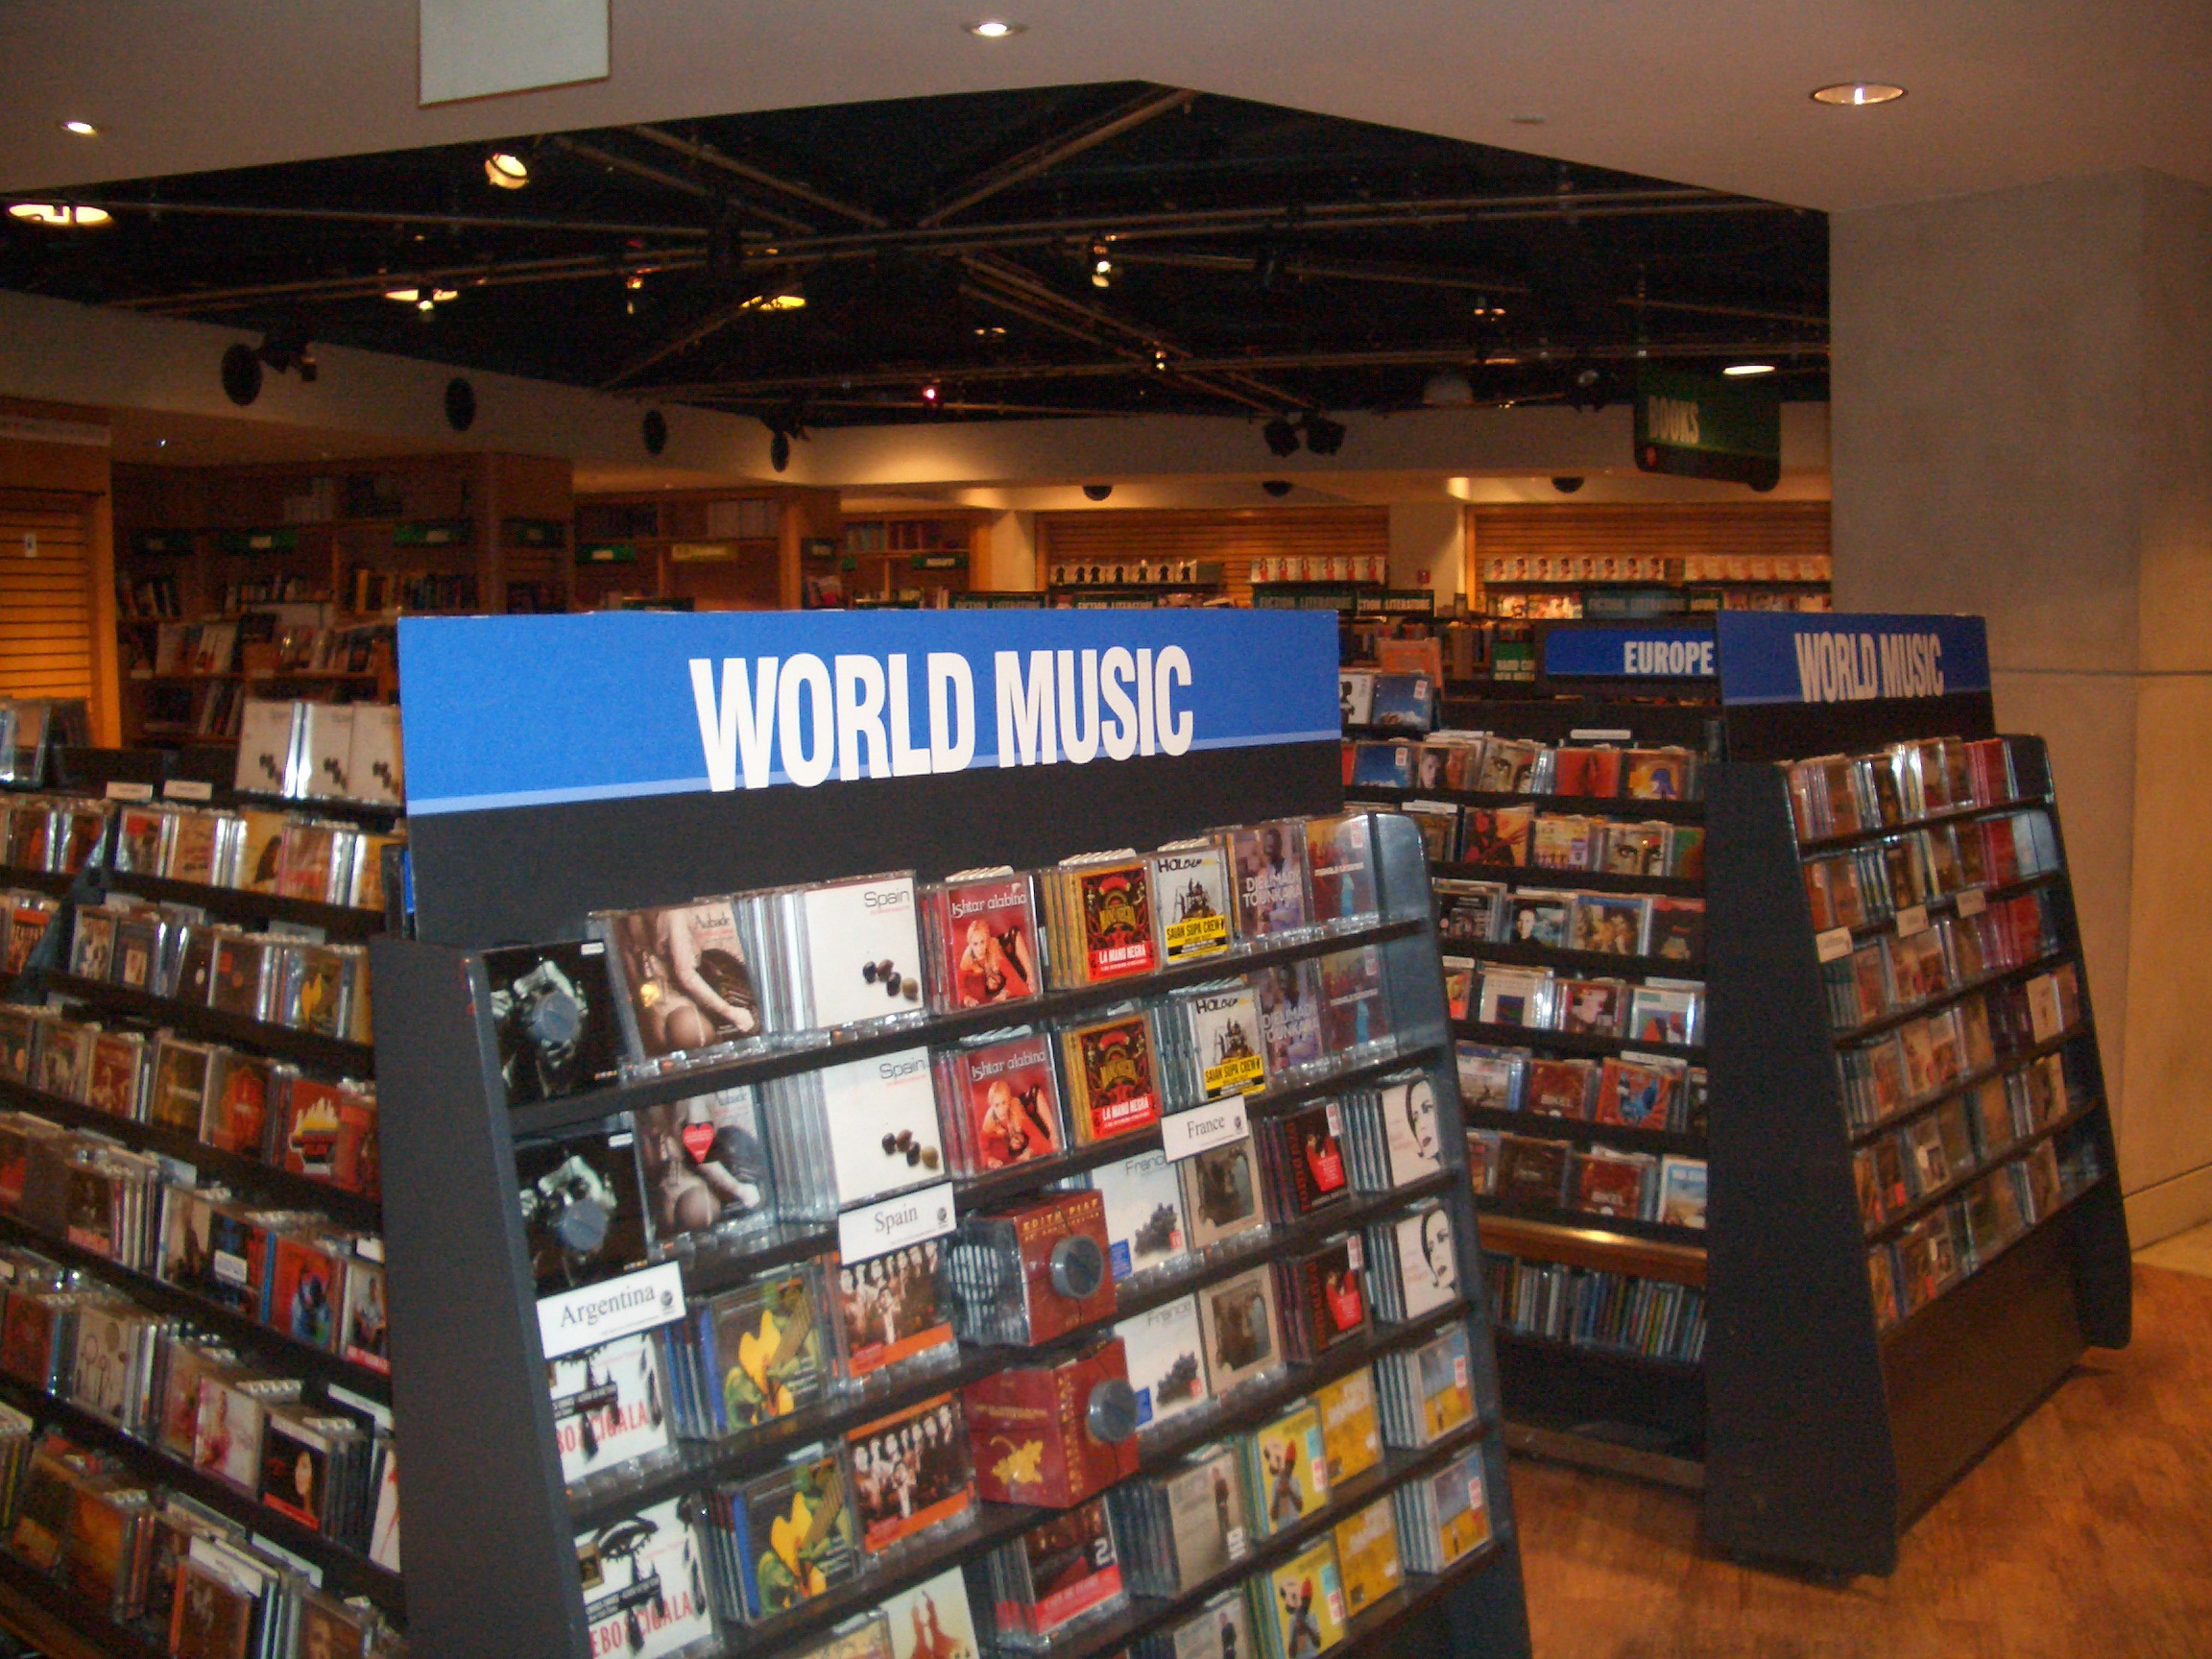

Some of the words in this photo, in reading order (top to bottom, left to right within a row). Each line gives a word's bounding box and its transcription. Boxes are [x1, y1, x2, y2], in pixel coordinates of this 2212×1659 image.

[1623, 640, 1715, 675] EUROPE
[1793, 631, 1878, 703] WORLD
[1880, 633, 1944, 698] MUSIC
[689, 653, 975, 792] WORLD
[995, 645, 1193, 768] MUSIC
[864, 887, 910, 909] Spain
[1186, 923, 1202, 937] SUPA
[1098, 950, 1108, 965] LA
[879, 1057, 926, 1079] Spain
[1187, 1117, 1225, 1139] France
[1125, 1155, 1166, 1176] Franc
[875, 1204, 918, 1235] Spain
[1022, 1210, 1064, 1232] EDITH
[560, 1285, 657, 1329] Argentina
